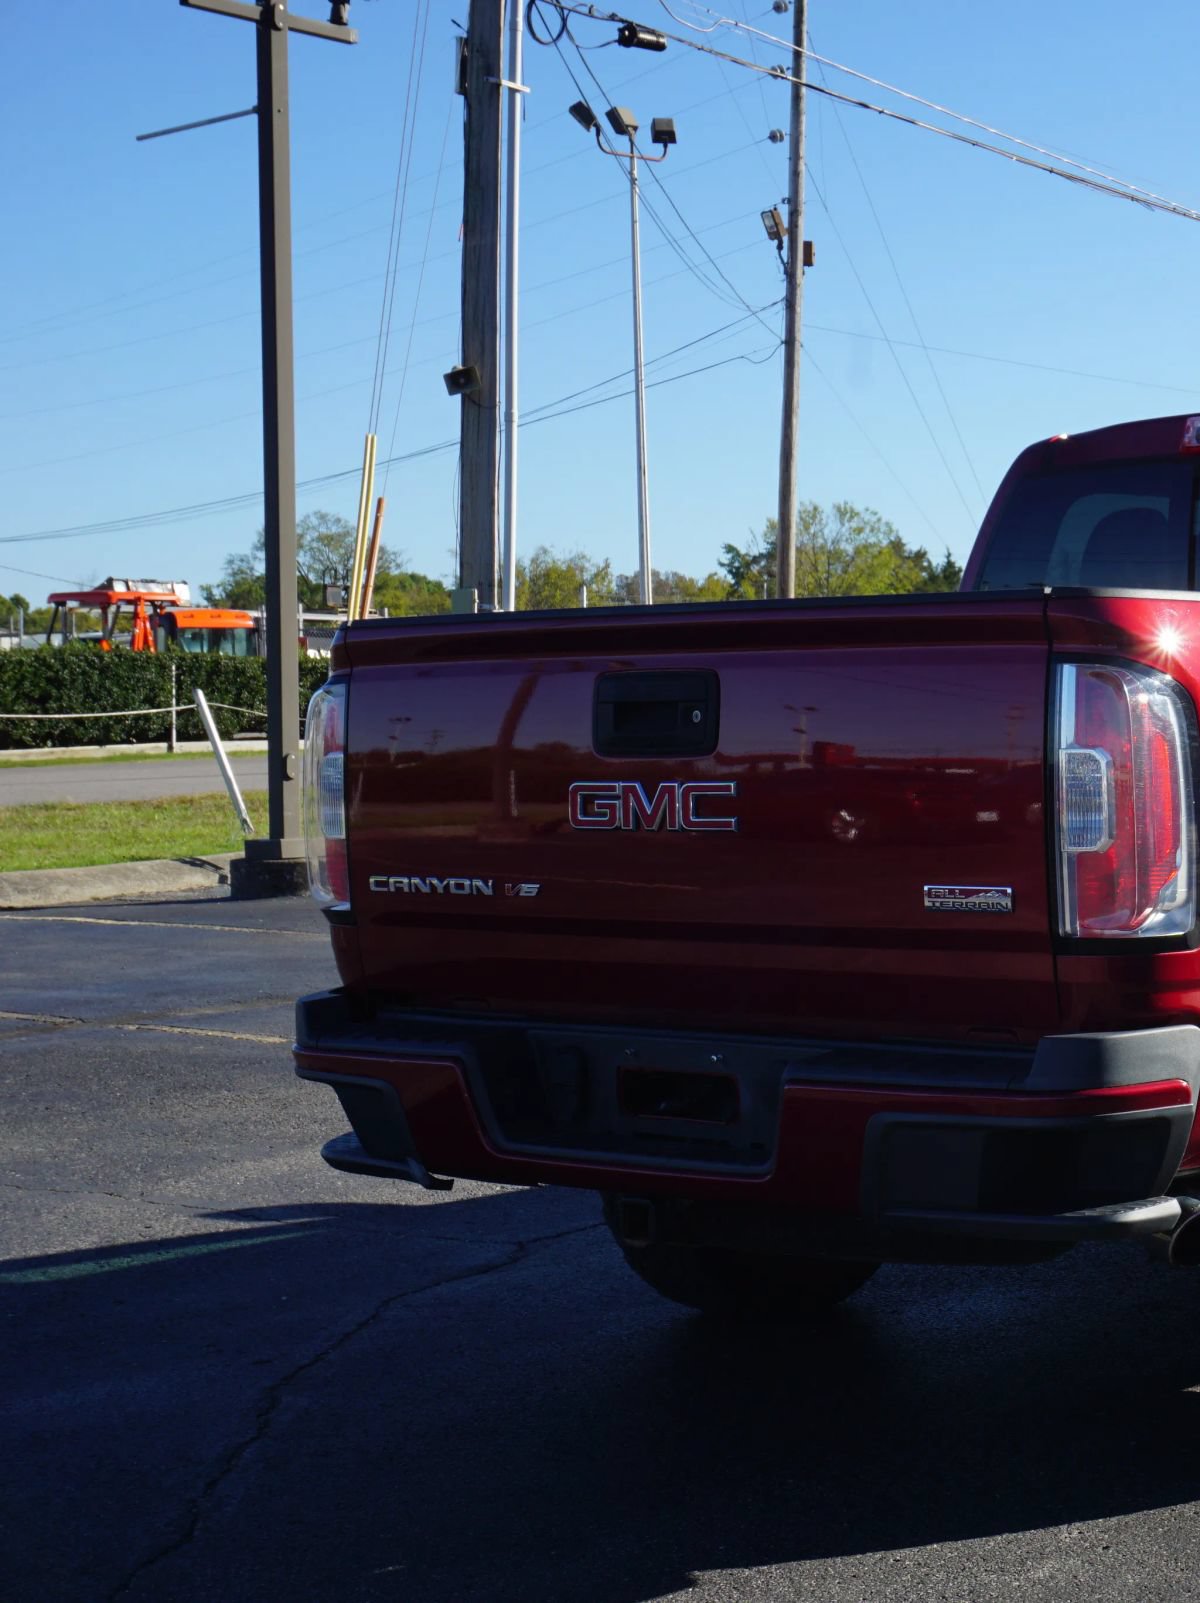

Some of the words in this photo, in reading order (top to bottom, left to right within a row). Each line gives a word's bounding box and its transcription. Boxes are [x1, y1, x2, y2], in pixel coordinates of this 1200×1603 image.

[569, 782, 737, 831] GMC
[368, 875, 494, 896] CANYON
[504, 883, 541, 897] V6
[931, 889, 966, 898] ALL
[927, 900, 1010, 911] TERRAIN
